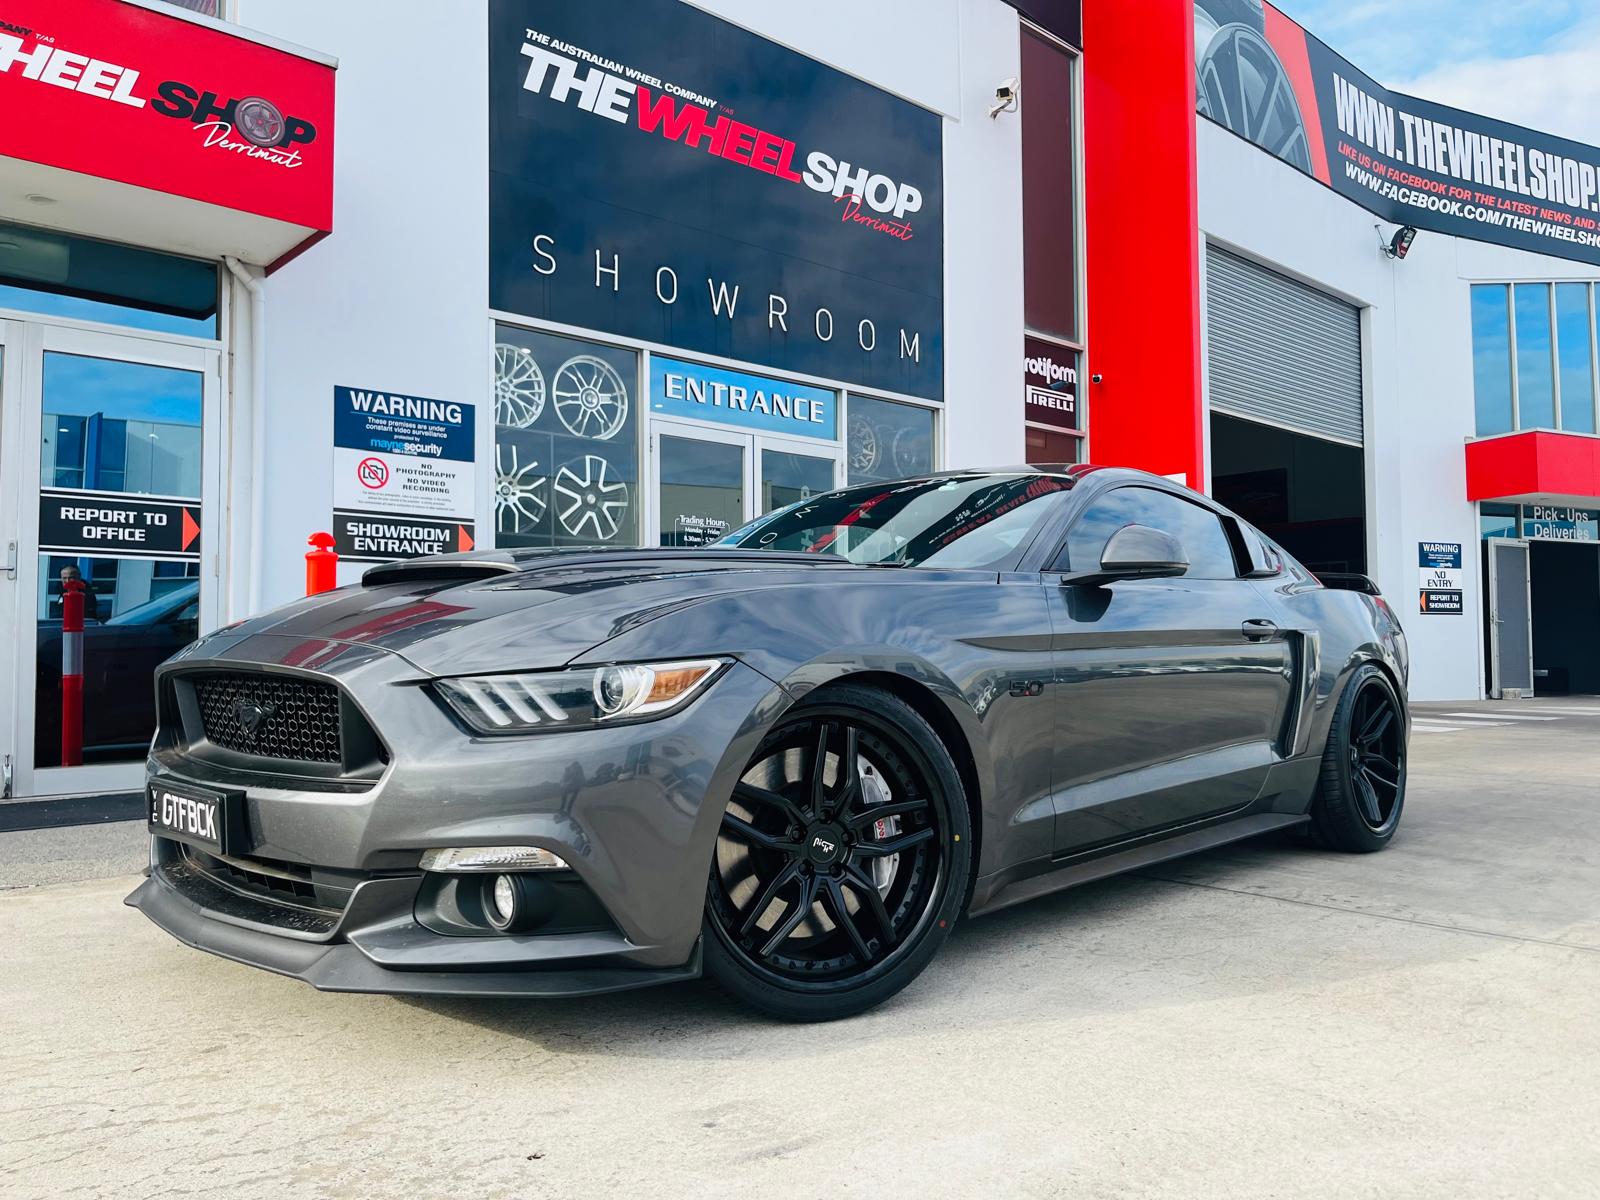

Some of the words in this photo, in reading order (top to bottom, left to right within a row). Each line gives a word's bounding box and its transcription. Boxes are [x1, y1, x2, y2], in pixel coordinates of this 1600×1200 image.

[35, 33, 55, 43] T/AS
[525, 28, 550, 46] THE
[550, 38, 624, 74] AUSTRALIAN
[625, 66, 663, 90] WHEEL
[664, 83, 717, 108] COMPANY
[520, 42, 637, 124] THE
[637, 86, 801, 184] WHEEL
[802, 151, 923, 219] SHOP
[193, 121, 303, 169] Derrimut
[1333, 71, 1600, 213] WWW.THEWHEELSHOP.
[1338, 140, 1357, 161] LIKE
[1358, 152, 1371, 169] US
[1372, 161, 1386, 177] ON
[1387, 167, 1447, 195] FACEBOOK
[1448, 186, 1472, 201] FOR
[1474, 192, 1496, 206] THE
[1497, 198, 1538, 216] LATEST
[1540, 208, 1572, 224] NEWS
[1573, 216, 1596, 230] AND
[833, 193, 913, 241] Derrimut
[532, 234, 920, 363] SHOWROOM
[1025, 357, 1077, 384] rotiform
[350, 390, 462, 424] WARNING
[664, 373, 825, 424] ENTRANCE
[1026, 384, 1074, 412] PIRELLI
[365, 423, 393, 433] constant
[394, 427, 411, 435] video
[412, 430, 448, 439] surveillance
[368, 416, 387, 426] These
[388, 420, 416, 429] premises
[428, 425, 446, 433] under
[396, 467, 456, 480] PHOTOGRAPHY
[421, 479, 446, 487] VIDEO
[402, 484, 450, 494] RECORDING
[60, 506, 137, 524] REPORT
[143, 512, 168, 527] TO
[680, 515, 704, 527] Trading
[706, 518, 726, 527] Hours
[1533, 506, 1558, 522] Pick
[1567, 508, 1588, 523] Ups
[82, 526, 146, 541] OFFICE
[346, 522, 450, 542] SHOWROOM
[685, 527, 703, 536] Monday
[1534, 521, 1590, 541] Deliveries
[354, 537, 443, 555] ENTRANCE
[1423, 543, 1459, 553] WARNING
[1427, 579, 1454, 588] ENTRY
[1434, 570, 1446, 579] NO
[1451, 594, 1459, 602] TO
[162, 793, 217, 839] GTFBCK
